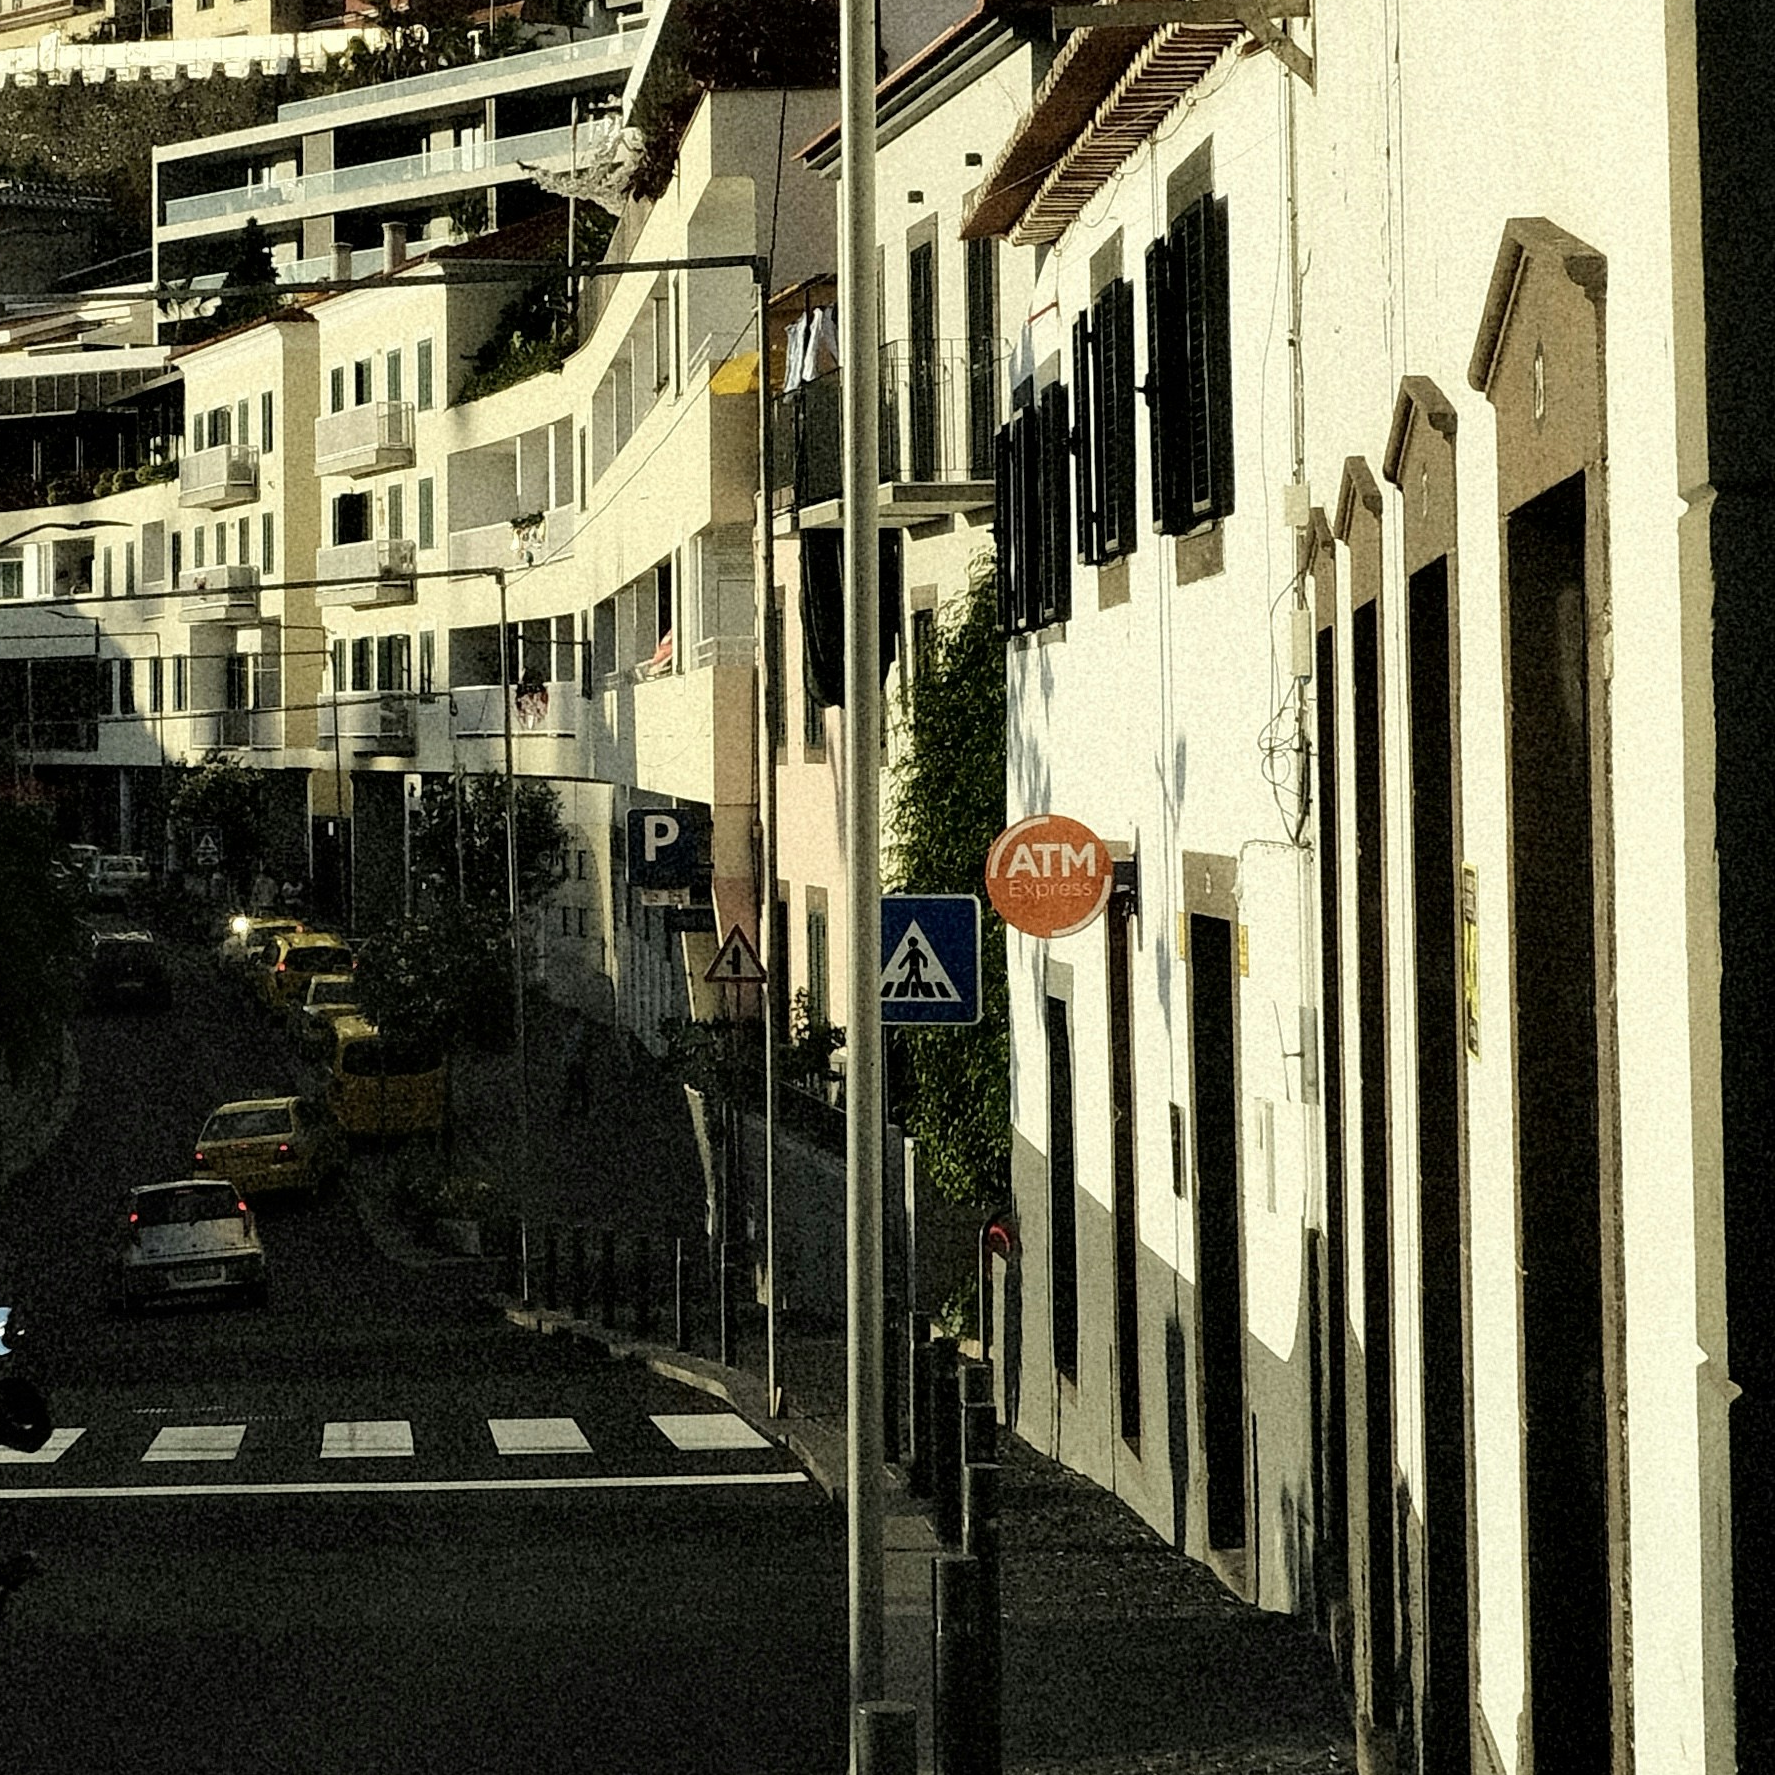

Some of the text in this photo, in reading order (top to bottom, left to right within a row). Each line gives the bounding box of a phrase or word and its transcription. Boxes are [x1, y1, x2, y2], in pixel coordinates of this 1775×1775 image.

[643, 813, 680, 862] P
[1005, 841, 1096, 879] ATM
[1008, 880, 1093, 901] Express
